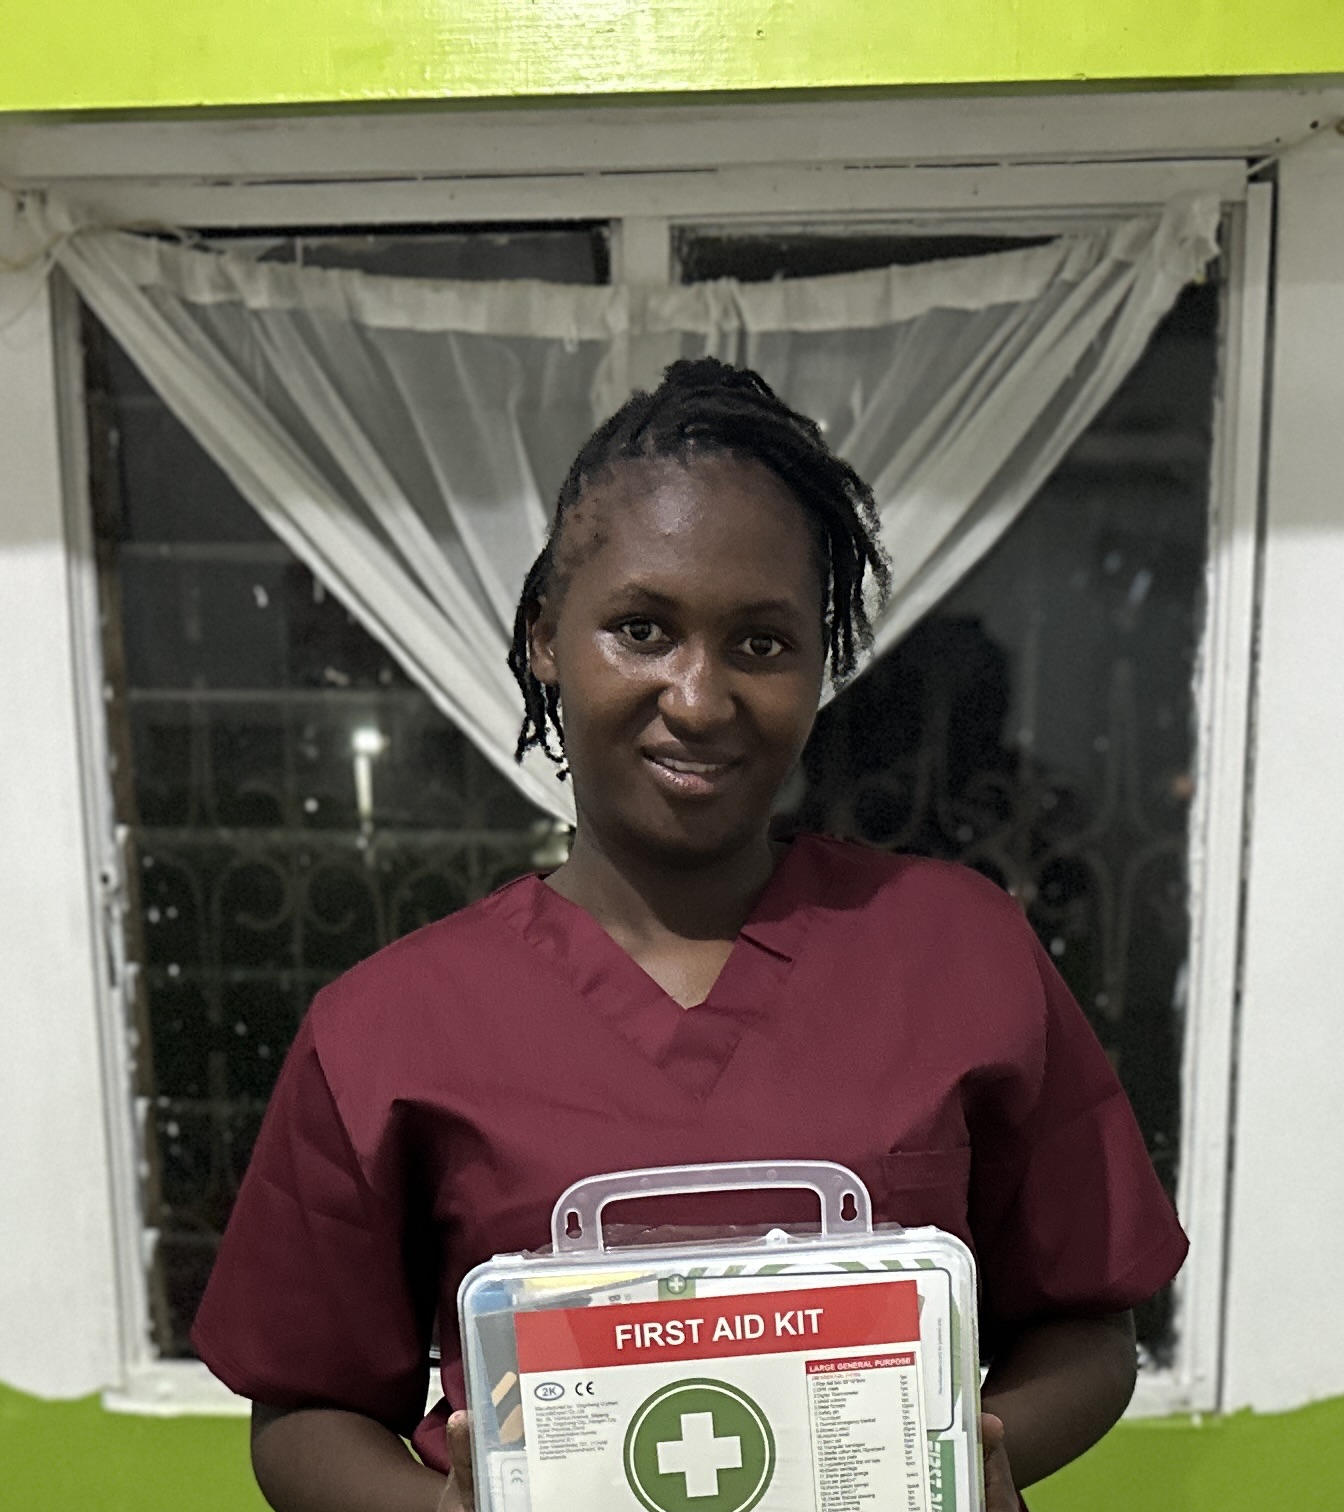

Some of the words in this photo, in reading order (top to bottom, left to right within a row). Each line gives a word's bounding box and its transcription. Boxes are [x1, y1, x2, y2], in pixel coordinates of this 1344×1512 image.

[615, 1318, 704, 1350] FIRST
[712, 1313, 765, 1342] AID
[774, 1308, 824, 1337] KIT
[808, 1363, 836, 1373] LARGE
[837, 1360, 873, 1370] GENERAL
[874, 1357, 911, 1367] PURPOSE
[541, 1386, 557, 1397] 2K
[574, 1380, 595, 1396] CE
